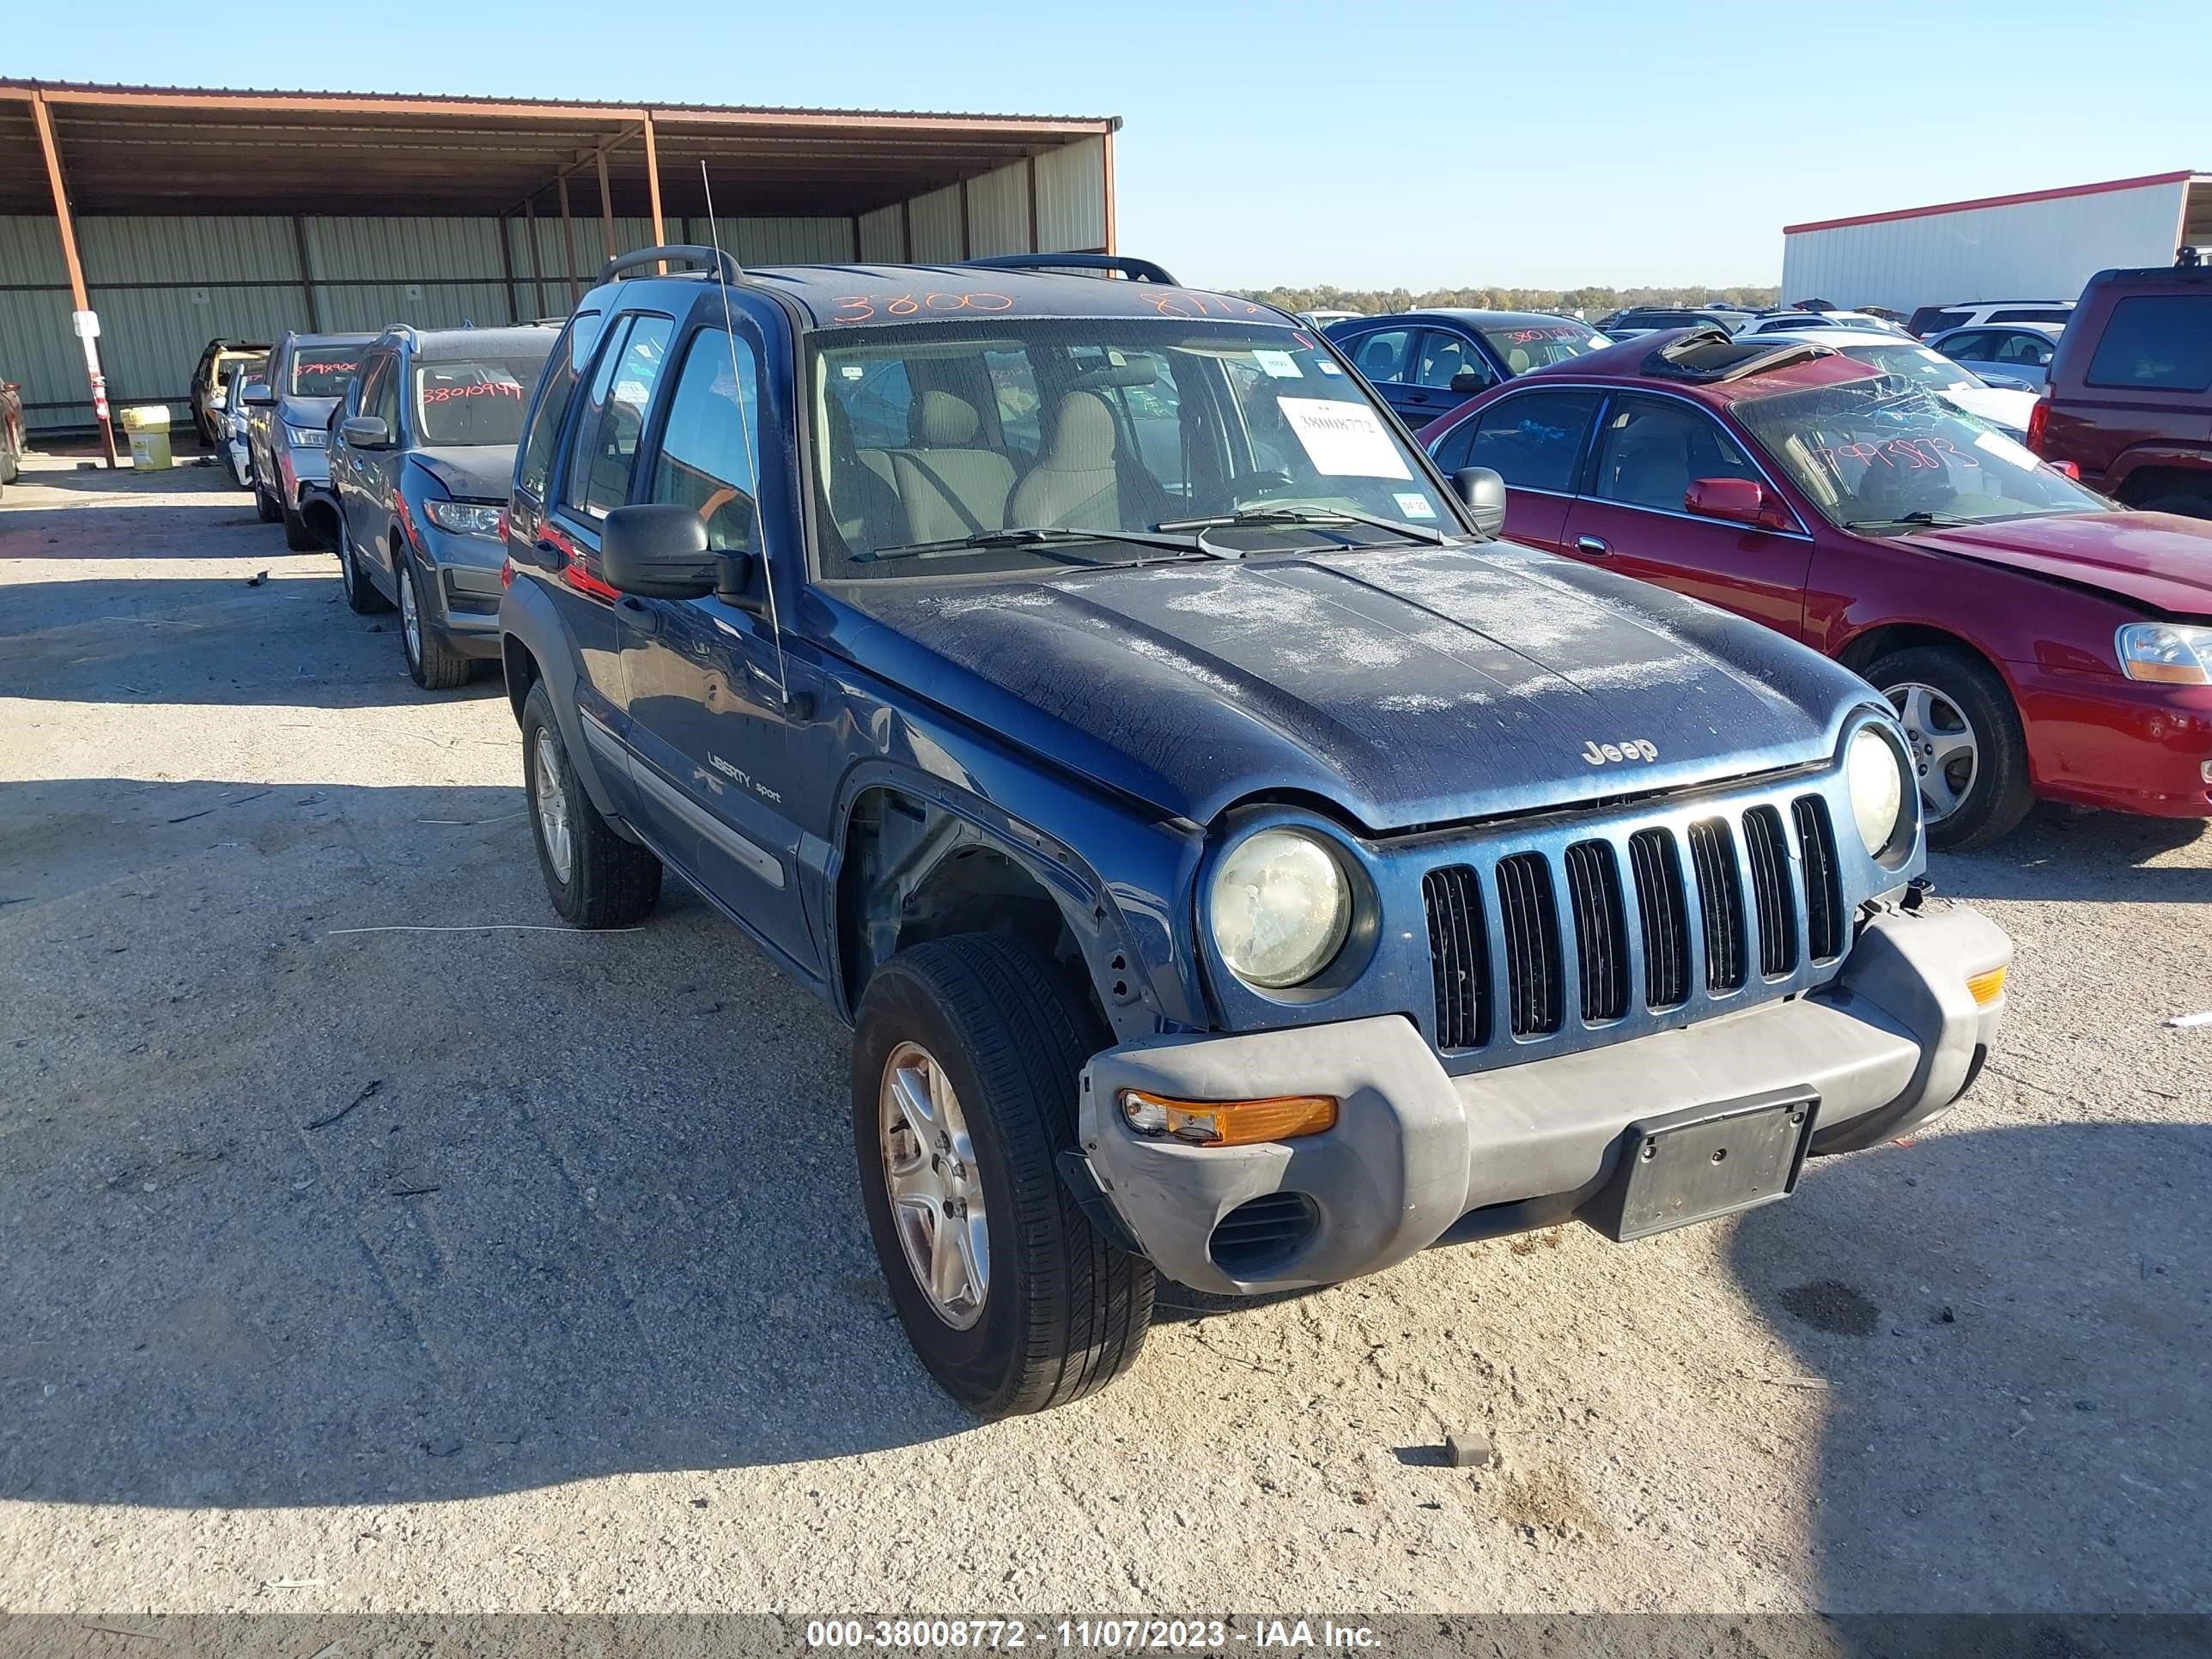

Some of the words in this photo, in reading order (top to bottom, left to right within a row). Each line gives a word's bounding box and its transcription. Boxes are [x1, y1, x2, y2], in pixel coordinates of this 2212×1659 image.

[1582, 738, 1658, 765] Jeep
[707, 750, 750, 788] LIBERTY
[756, 782, 781, 804] sport
